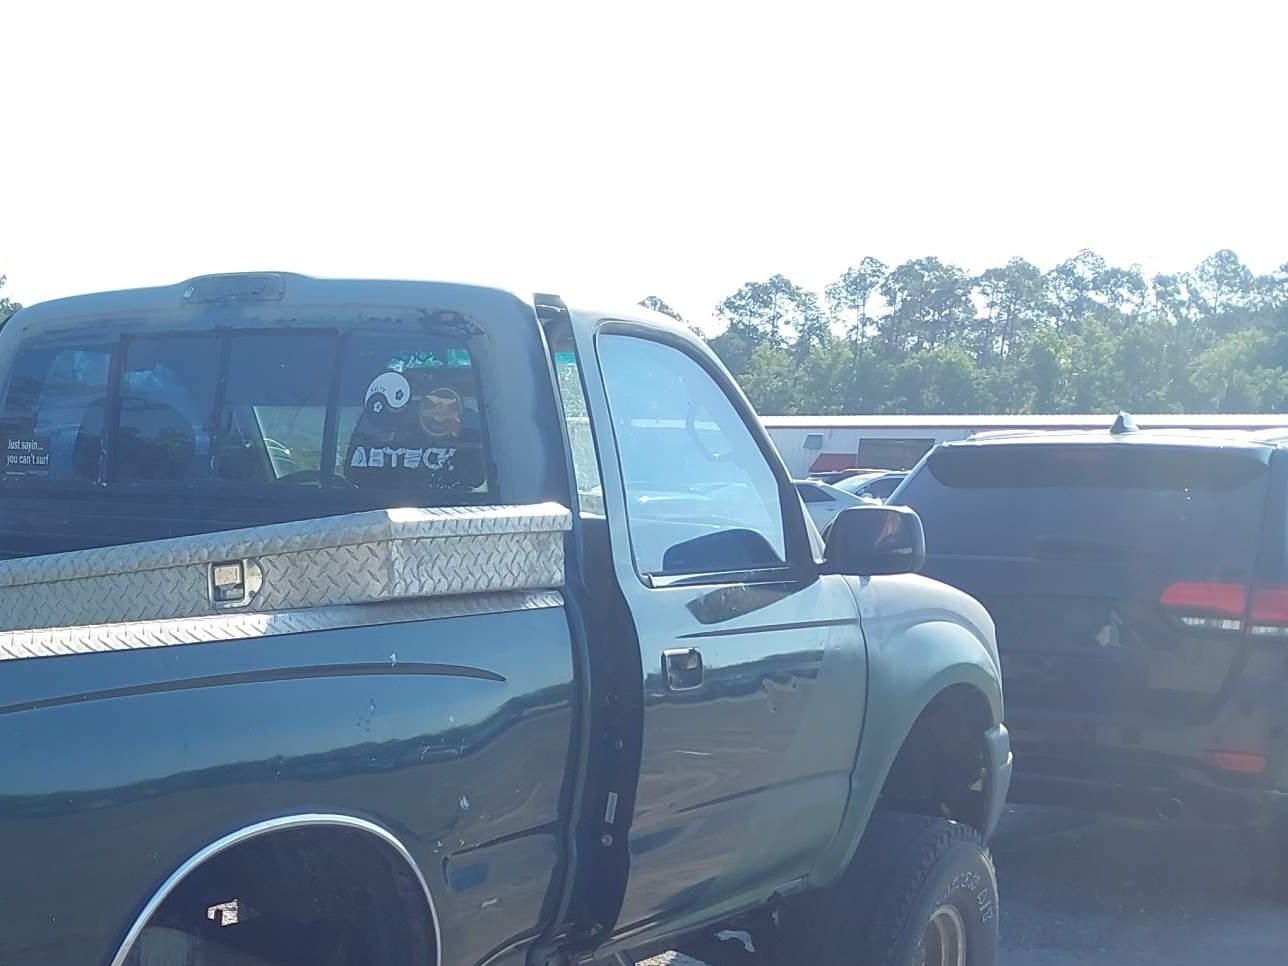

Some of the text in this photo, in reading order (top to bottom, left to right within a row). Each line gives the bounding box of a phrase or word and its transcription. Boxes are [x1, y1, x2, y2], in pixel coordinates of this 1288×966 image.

[8, 439, 20, 450] Just
[6, 454, 49, 466] you can't surf
